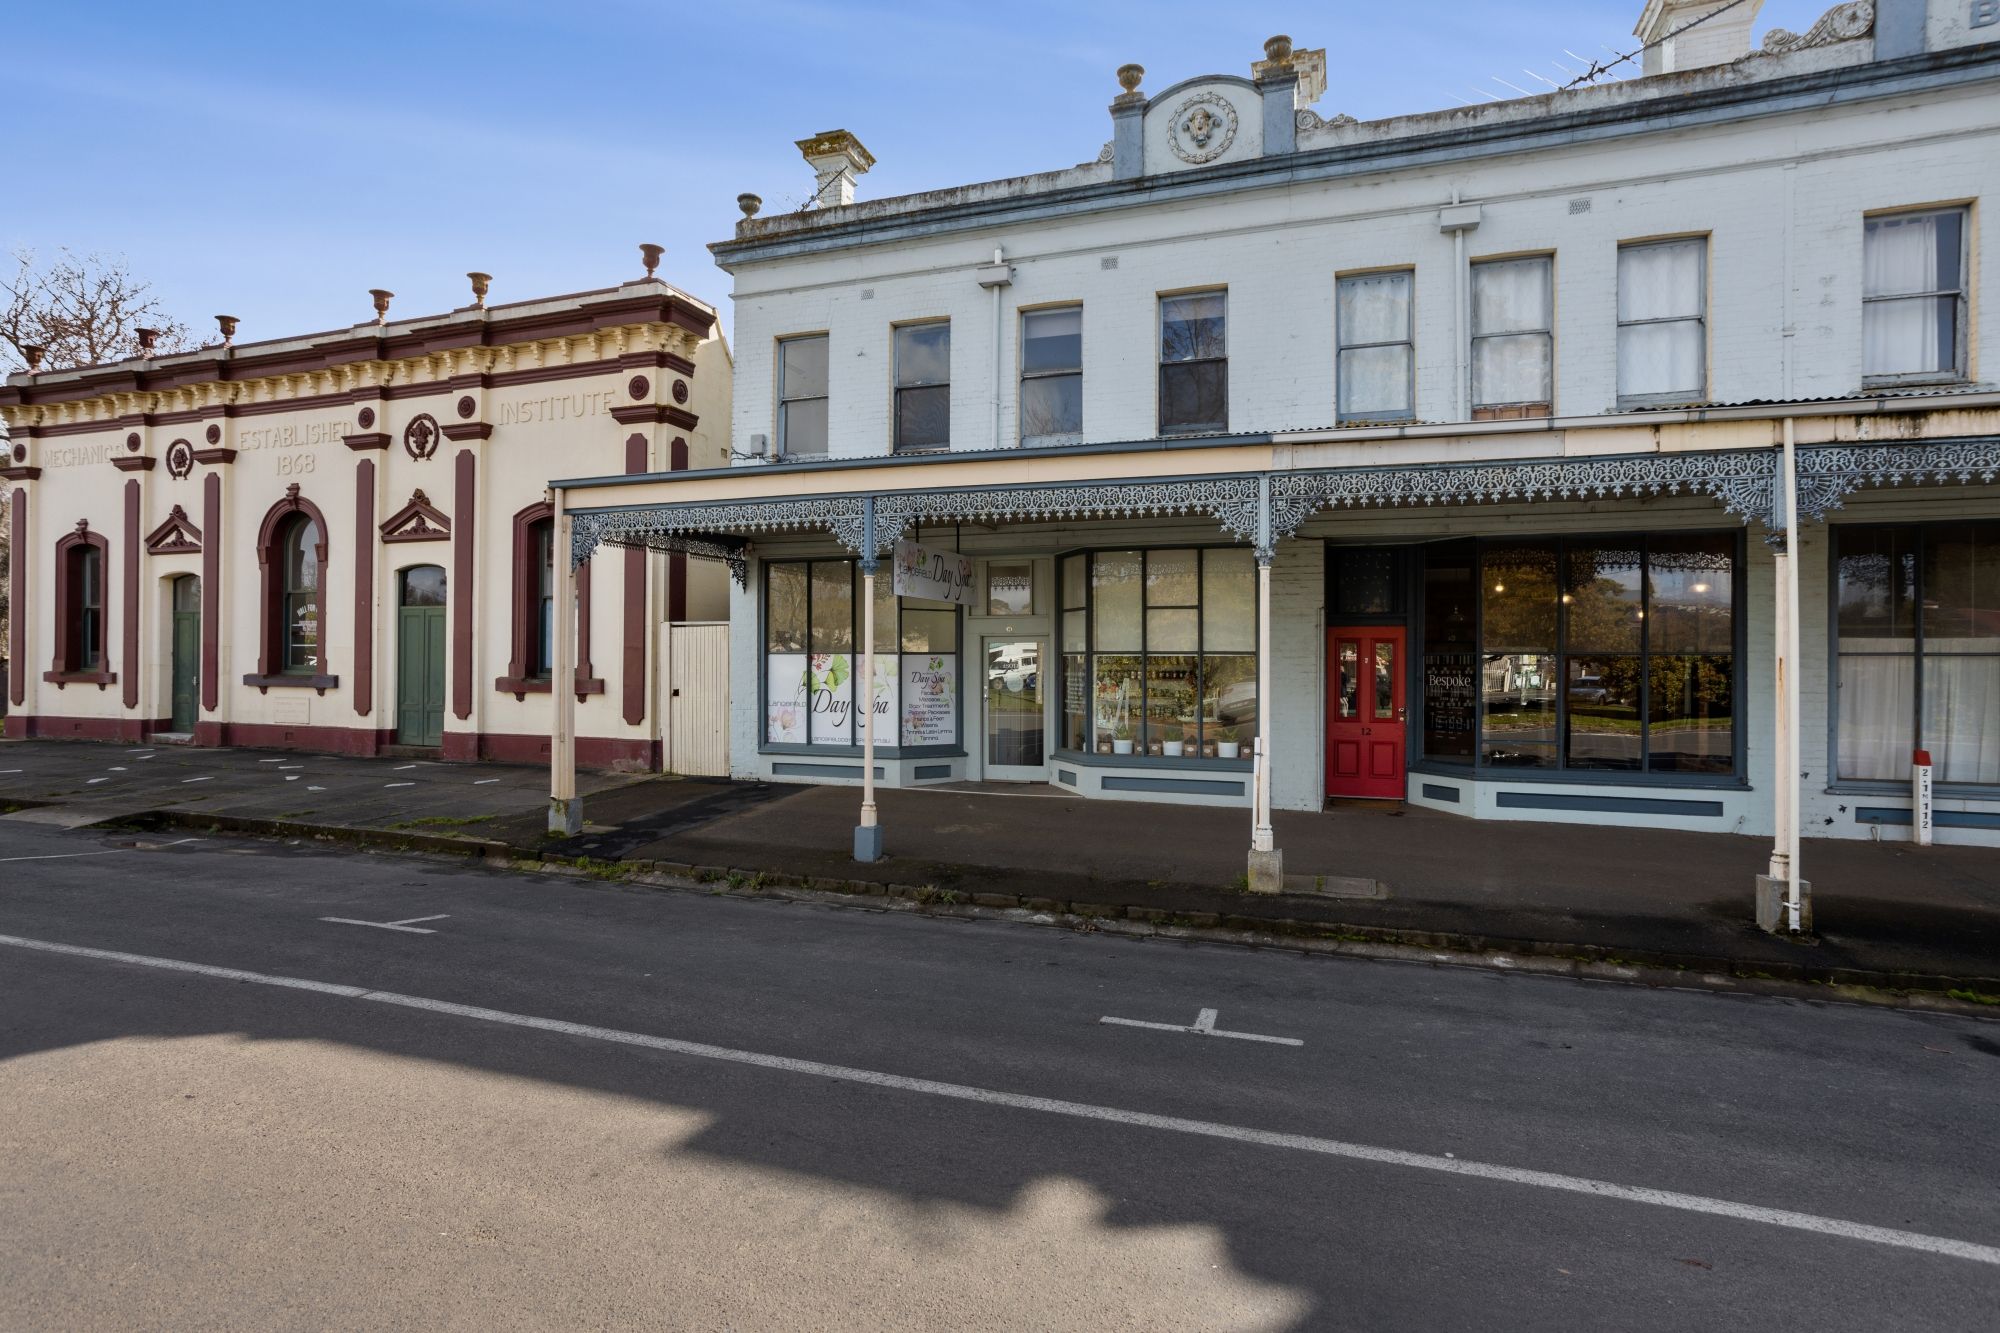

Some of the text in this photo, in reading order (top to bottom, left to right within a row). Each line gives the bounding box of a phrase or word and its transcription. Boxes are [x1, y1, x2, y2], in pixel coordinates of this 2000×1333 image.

[499, 390, 615, 425] INSTITUTE
[240, 422, 354, 451] ESTABLISHED
[276, 453, 315, 476] 1868
[933, 554, 954, 599] Day
[955, 559, 970, 600] Spa
[912, 671, 946, 689] Day Spa
[1429, 675, 1471, 689] Bespoke
[813, 690, 851, 727] Day
[1361, 727, 1372, 736] 12
